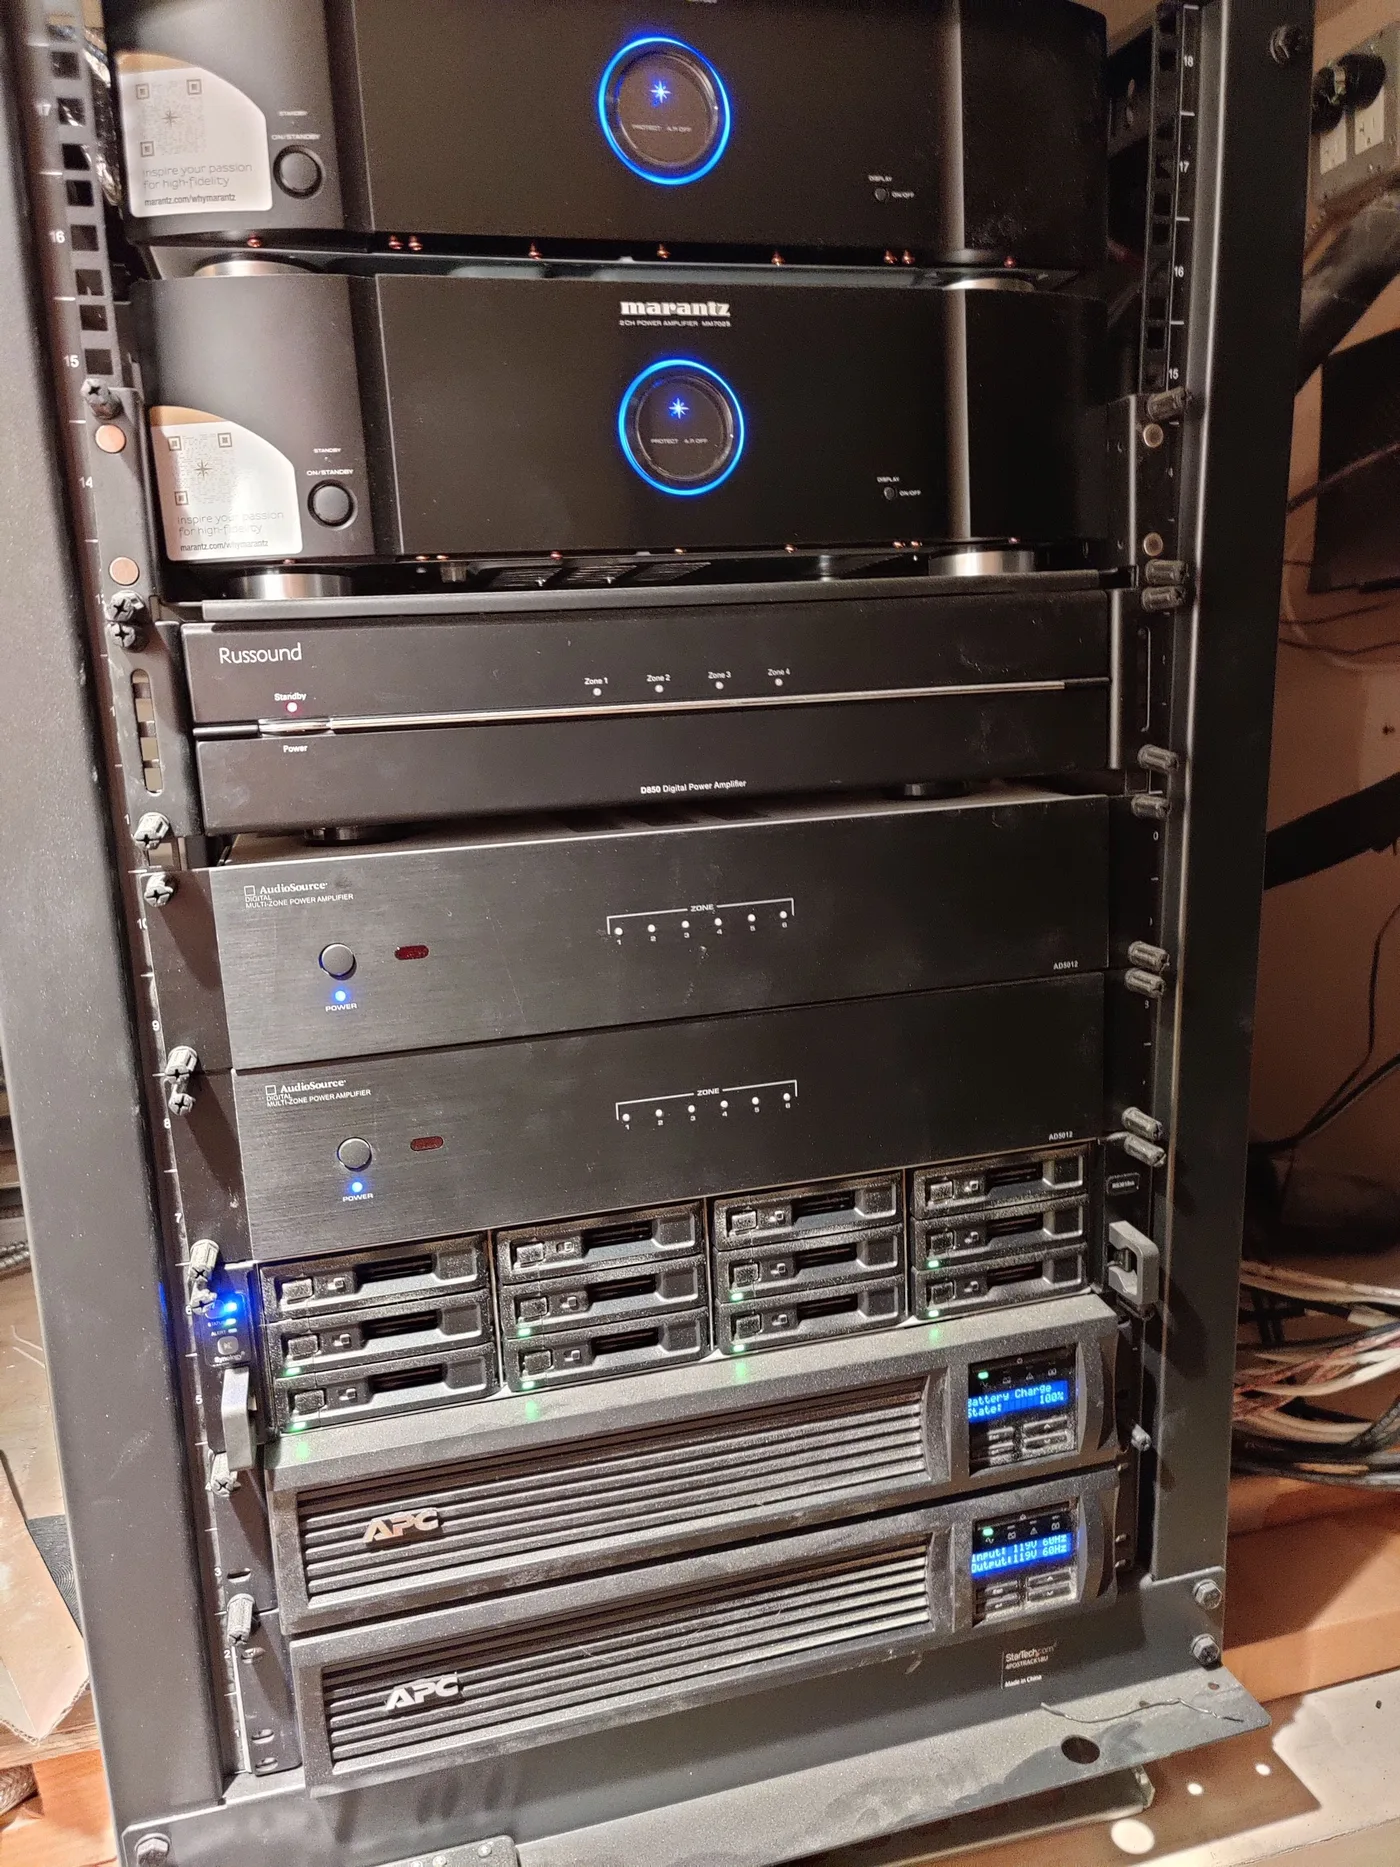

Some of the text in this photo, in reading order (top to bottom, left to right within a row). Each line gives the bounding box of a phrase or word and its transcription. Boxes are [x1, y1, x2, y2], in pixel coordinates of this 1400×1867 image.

[1183, 54, 1194, 68] 18
[37, 103, 52, 117] 17
[271, 133, 321, 141] ON/STANDBY
[182, 164, 206, 176] your
[209, 162, 253, 174] passion
[1179, 160, 1190, 173] 17
[143, 176, 230, 190] for high-fidelity
[144, 193, 236, 206] marantz.com/whymarantz
[49, 231, 65, 244] 16
[1174, 265, 1185, 278] 16
[620, 301, 731, 317] marantz
[63, 354, 80, 368] 15
[1168, 368, 1179, 380] 15
[79, 476, 93, 489] 14
[178, 526, 196, 537] for
[180, 540, 269, 552] marantz.com/whymarantz
[219, 642, 302, 664] Russound
[646, 674, 671, 682] Zone 2
[708, 671, 732, 680] Zone 3
[767, 668, 791, 677] Zone 4
[584, 677, 602, 686] Zone
[274, 692, 307, 702] Standby
[283, 744, 308, 753] Power
[640, 780, 747, 795] D850 Digital Power Amplifier
[260, 882, 326, 895] AudioSource
[245, 894, 272, 903] DIGITAL
[245, 893, 354, 909] MULTI-ZONE POWER AMPLIFIER
[690, 903, 714, 912] ZONE
[325, 1002, 358, 1012] POWER
[152, 1019, 160, 1031] 9
[280, 1079, 346, 1093] AudioSource
[697, 1087, 720, 1096] ZONE
[266, 1093, 292, 1102] DIGITAL
[267, 1089, 372, 1108] MULTI-ZONE POWER AMPLIFIER
[163, 1117, 171, 1129] 8
[342, 1192, 374, 1202] POWER
[174, 1212, 182, 1224] 7
[185, 1304, 193, 1315] 6
[211, 1329, 227, 1337] ALERT
[195, 1394, 203, 1406] 5
[967, 1384, 1052, 1408] Battery Charge
[967, 1391, 1064, 1419] State: 100%
[363, 1508, 439, 1544] APC
[971, 1547, 1006, 1563] Input:
[1013, 1540, 1037, 1553] 119V
[1042, 1544, 1067, 1557] 60Hz
[214, 1566, 222, 1577] 3
[224, 1649, 231, 1659] 2
[1005, 1679, 1020, 1688] Made
[1026, 1674, 1042, 1683] China
[386, 1673, 459, 1711] APC
[234, 1729, 240, 1738] 1
